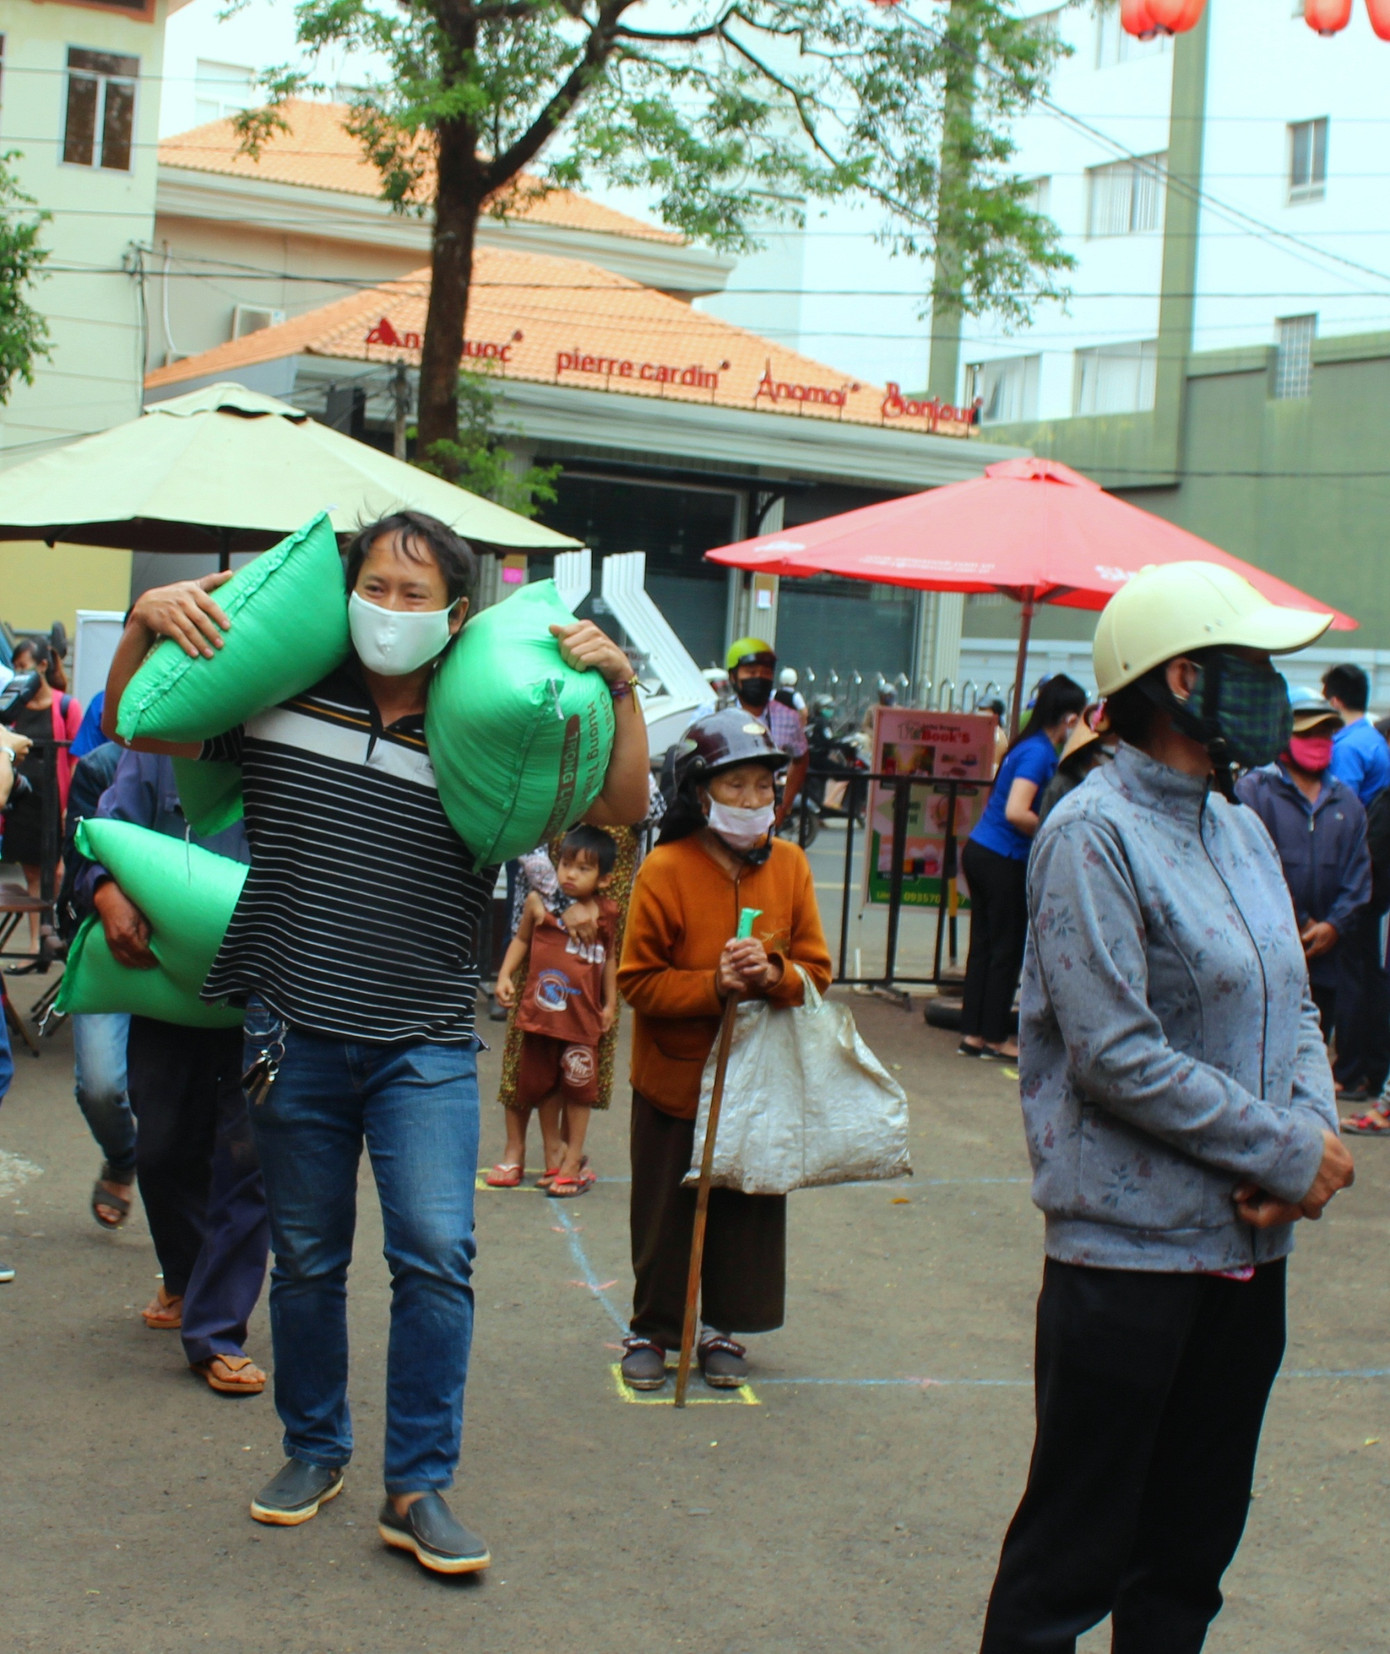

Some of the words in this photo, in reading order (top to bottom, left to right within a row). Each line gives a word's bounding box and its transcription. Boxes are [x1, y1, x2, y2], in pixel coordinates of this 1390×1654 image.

[557, 348, 634, 378] pierre
[640, 362, 719, 390] cardin
[881, 381, 977, 432] Bonjour
